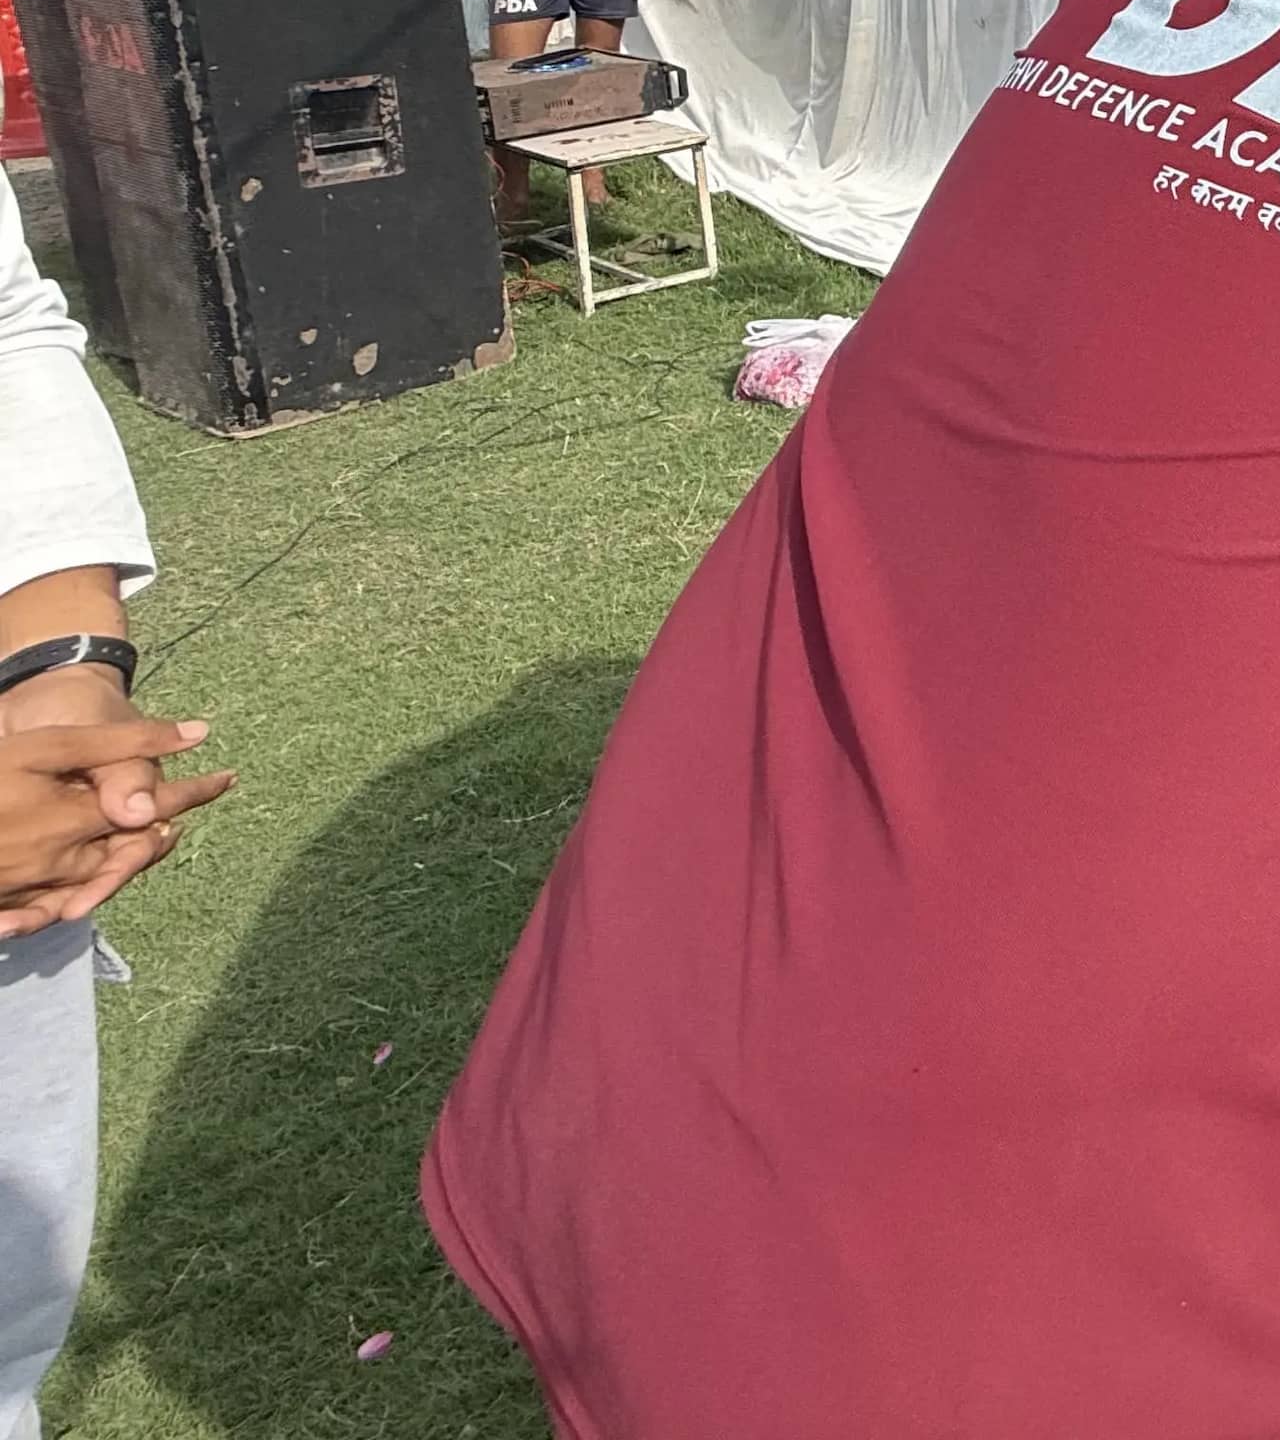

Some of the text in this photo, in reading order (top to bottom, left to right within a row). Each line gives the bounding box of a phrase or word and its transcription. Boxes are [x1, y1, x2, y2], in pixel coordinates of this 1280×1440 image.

[1037, 63, 1196, 142] DEFENCE
[1153, 164, 1190, 201] हर
[1190, 178, 1255, 221] कदम
